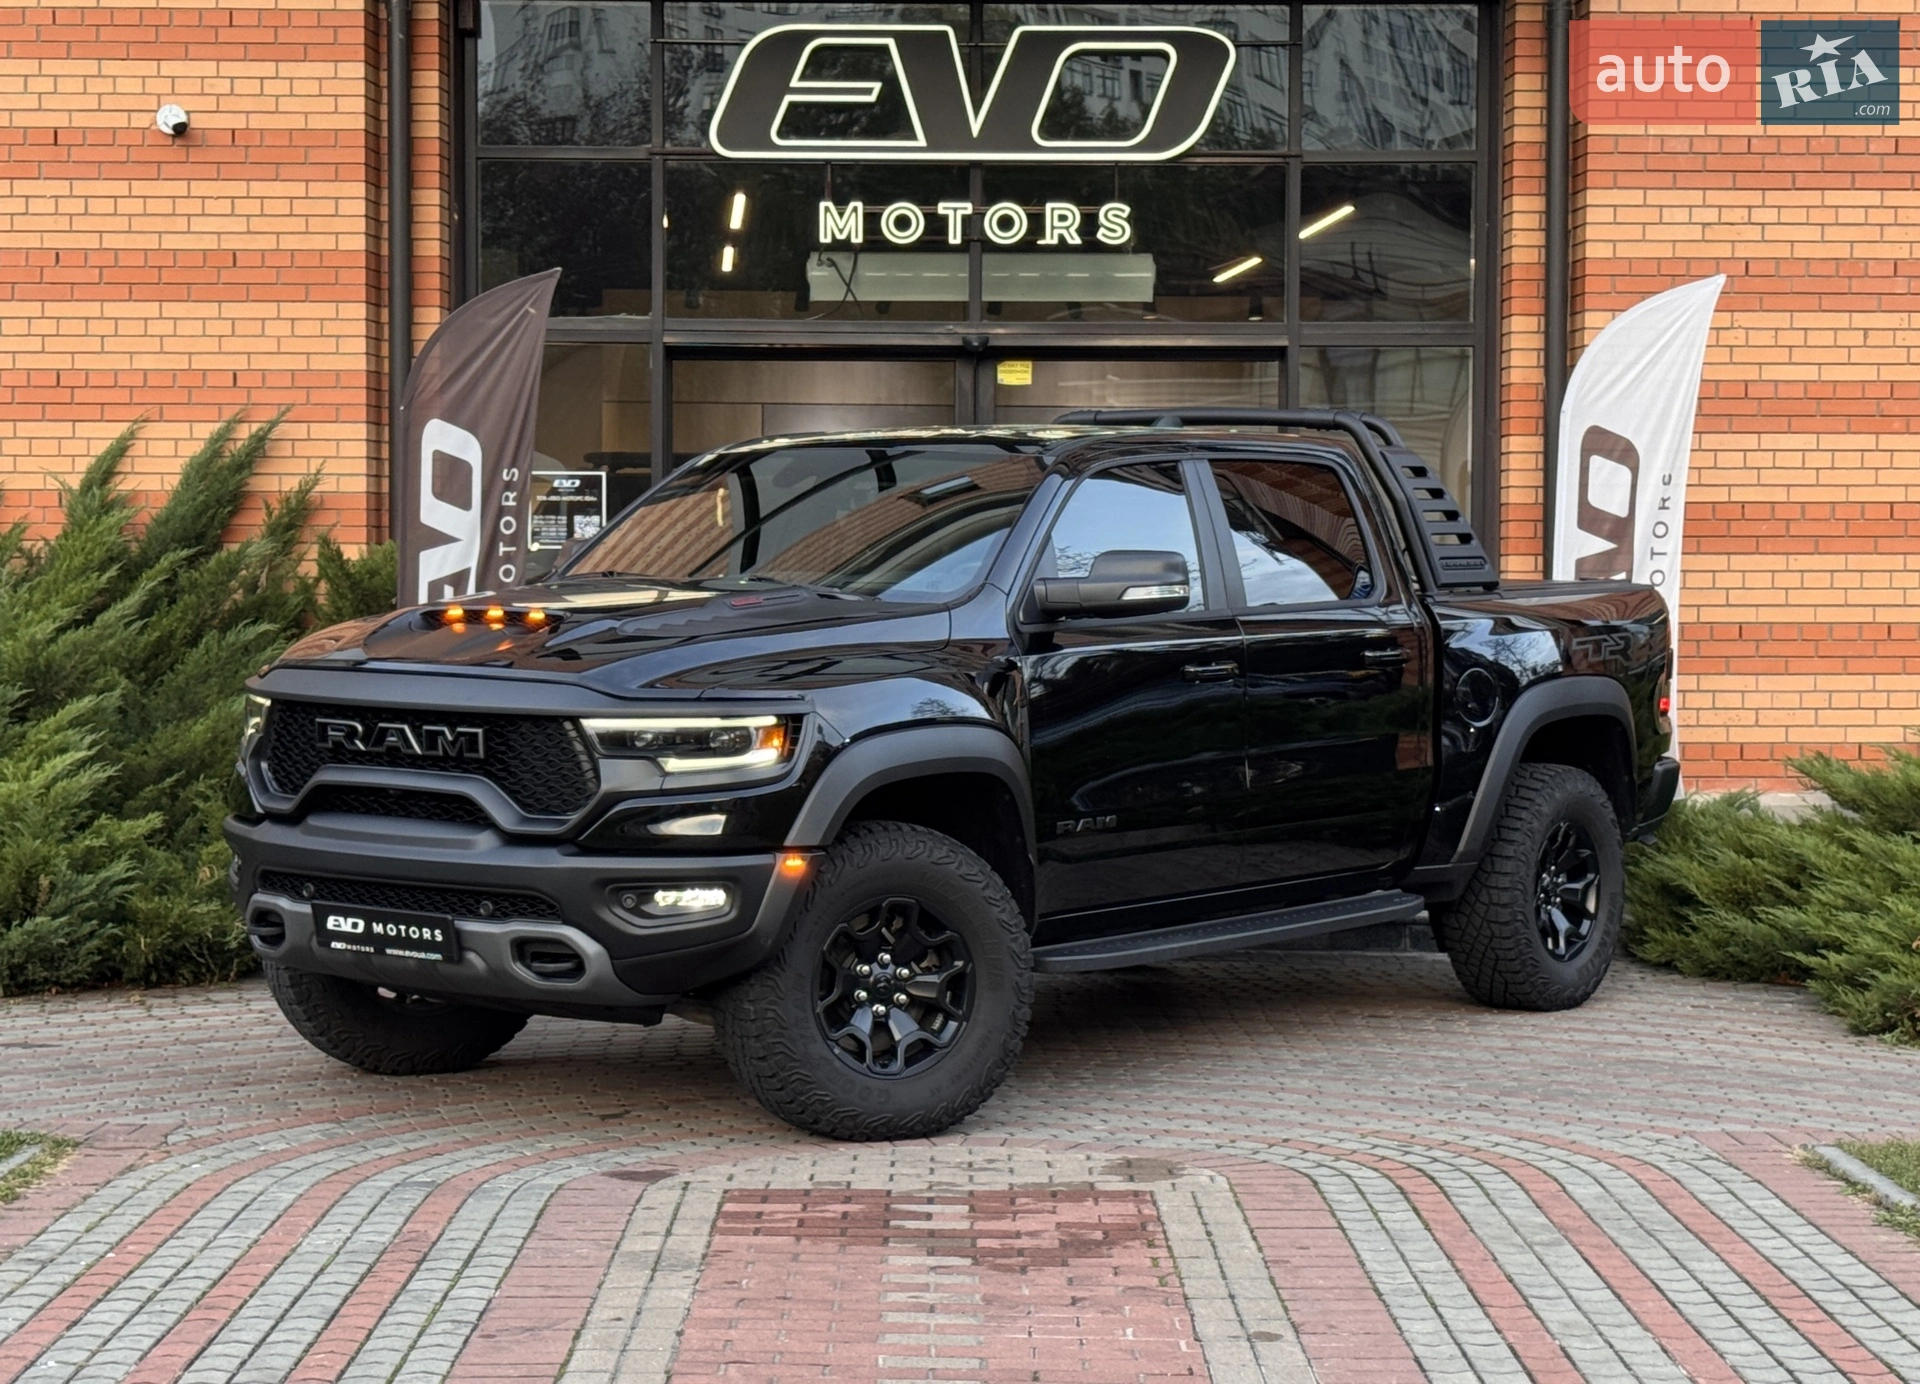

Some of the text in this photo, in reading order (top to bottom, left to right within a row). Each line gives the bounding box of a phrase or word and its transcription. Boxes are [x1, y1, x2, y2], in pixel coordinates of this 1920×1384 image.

[709, 24, 1237, 161] EVO
[818, 201, 1131, 245] MOTORS
[498, 467, 520, 583] OTORS
[315, 718, 484, 759] RAM
[1056, 815, 1117, 835] RAM
[326, 915, 444, 942] EVO MOTORS
